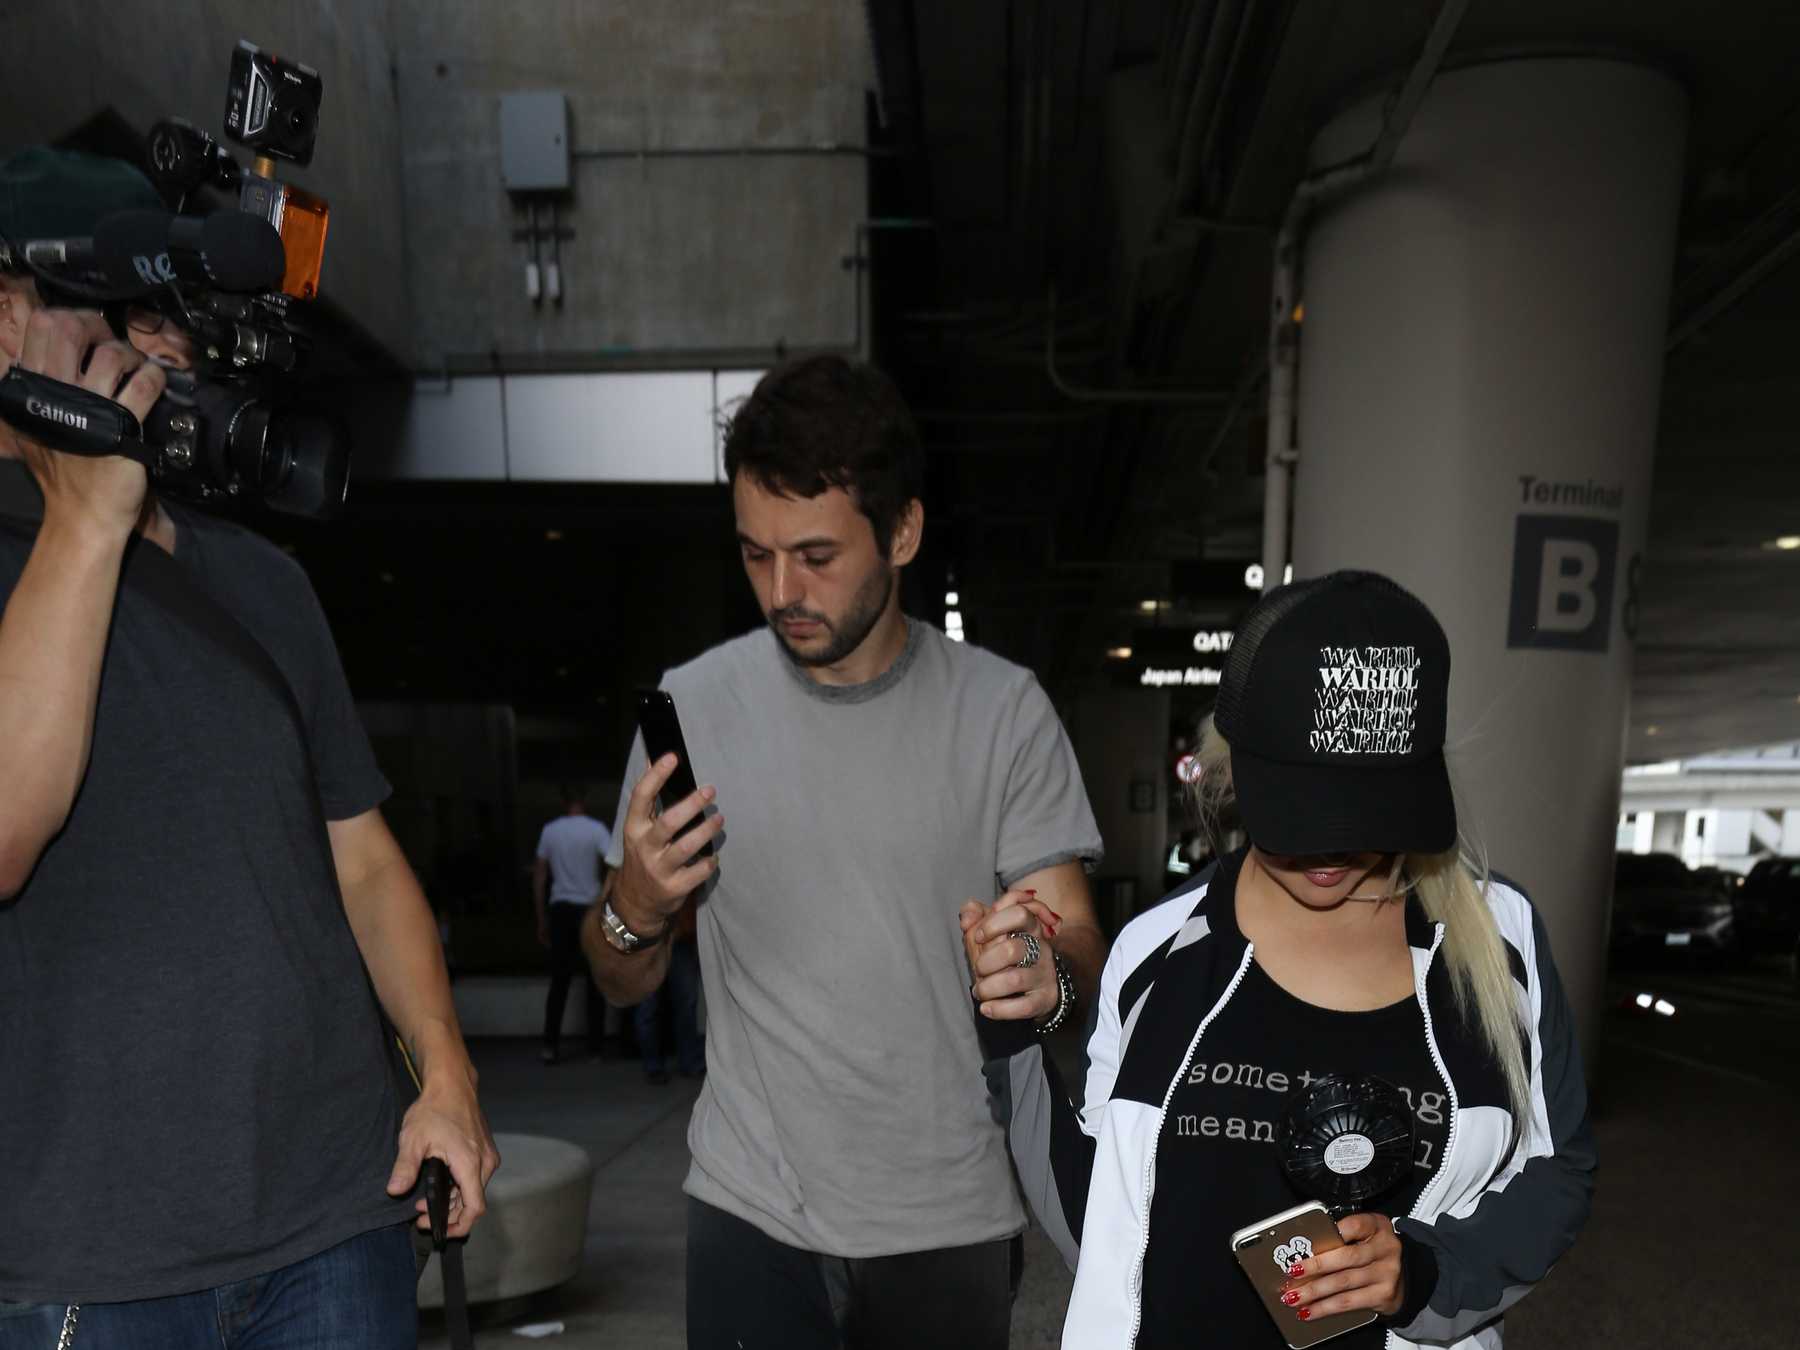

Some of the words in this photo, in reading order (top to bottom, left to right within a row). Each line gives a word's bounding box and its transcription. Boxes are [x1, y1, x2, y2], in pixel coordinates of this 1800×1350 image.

[26, 397, 88, 431] Canon
[1517, 475, 1624, 509] Terminal
[1537, 538, 1600, 633] B
[1193, 631, 1235, 652] QAT
[1320, 646, 1420, 669] WARHOL
[1319, 667, 1418, 690] WARHOL
[1314, 688, 1418, 710] WARHOL
[1313, 709, 1415, 731] WARHOL
[1309, 730, 1412, 754] WARHOL
